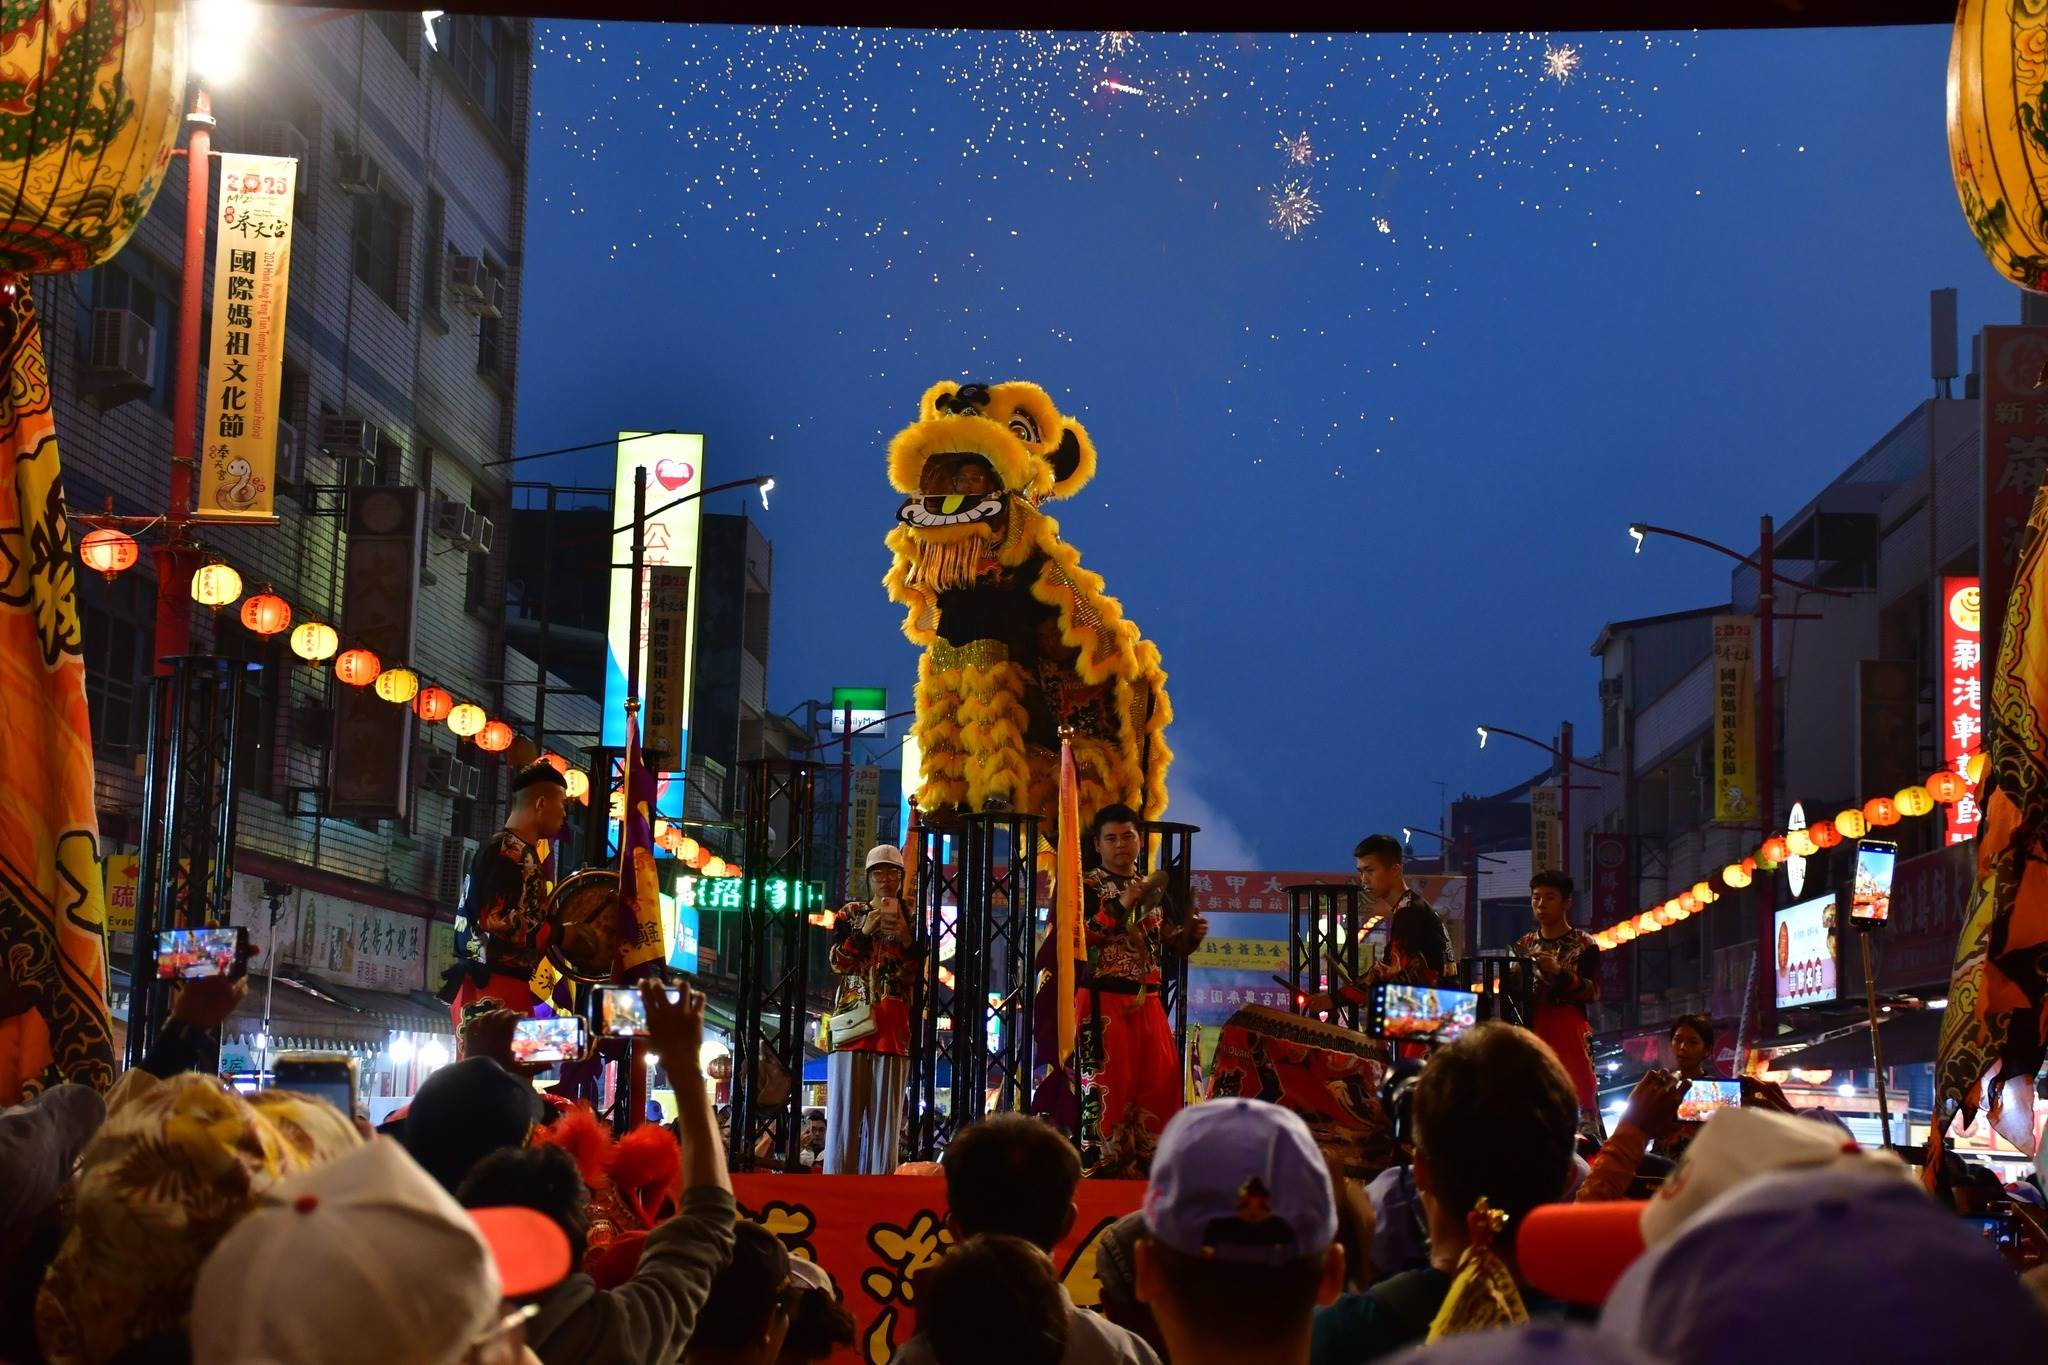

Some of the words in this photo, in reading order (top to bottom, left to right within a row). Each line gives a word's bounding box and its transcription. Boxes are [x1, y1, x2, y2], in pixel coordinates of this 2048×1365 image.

[227, 174, 287, 195] 2025
[229, 210, 288, 239] 奉天宮
[263, 252, 275, 267] 2024
[262, 267, 273, 282] Hsin
[258, 283, 272, 299] Kang
[257, 300, 271, 315] Feng
[219, 248, 256, 438] 國際媽祖文化節
[256, 330, 270, 352] Temple
[253, 373, 267, 414] International
[1721, 668, 1736, 775] 國際媽祖文化節
